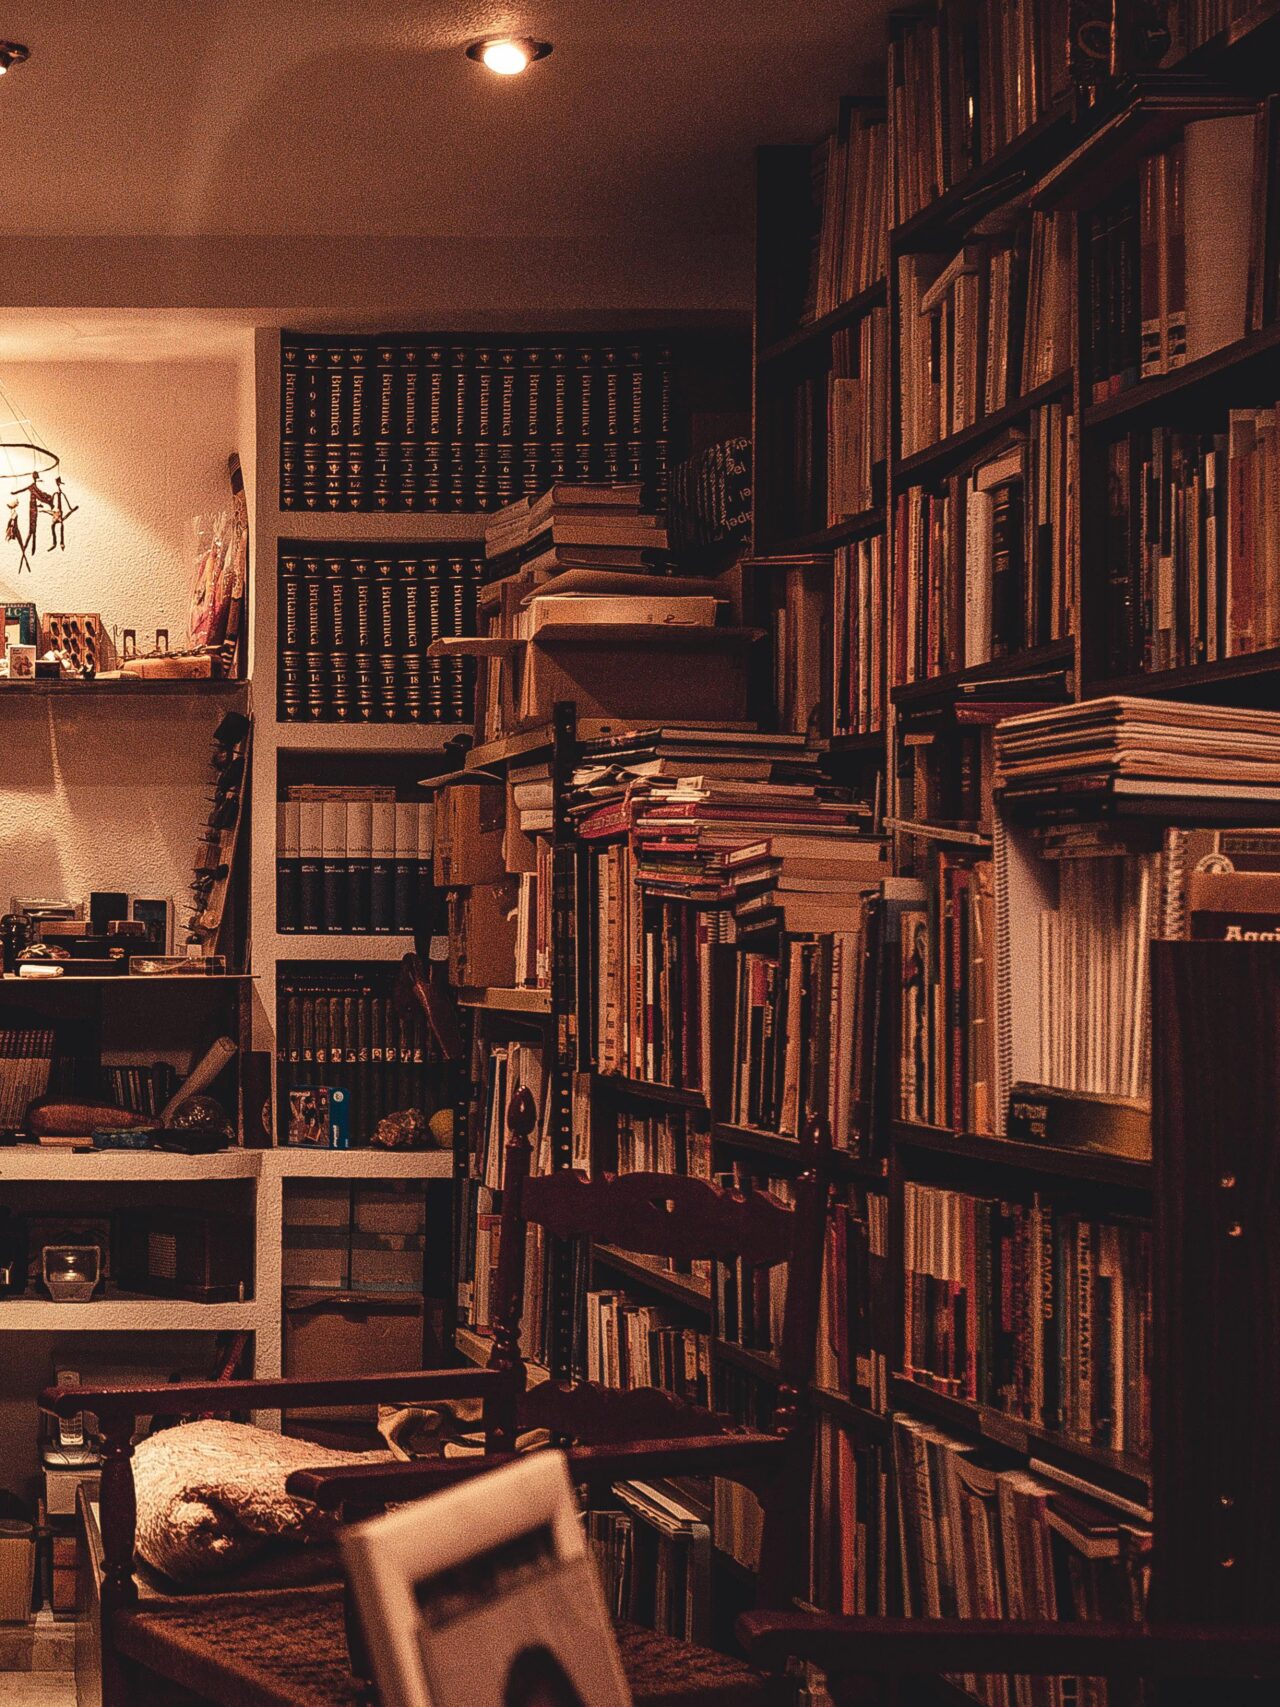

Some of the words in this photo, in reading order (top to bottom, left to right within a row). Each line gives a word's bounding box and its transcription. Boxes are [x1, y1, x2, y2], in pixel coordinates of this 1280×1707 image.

[285, 373, 296, 434] Britannica
[330, 375, 342, 436] Britannica
[352, 375, 364, 436] Britannica
[381, 373, 393, 435] Britannica
[406, 373, 417, 435] Britannica
[431, 373, 442, 434] Britannica
[457, 374, 466, 435] Britannica
[480, 375, 491, 435] Britannica
[503, 376, 514, 436] Britannica
[528, 374, 540, 435] Britannica
[555, 374, 565, 435] Britannica
[582, 375, 592, 436] Britannica
[607, 374, 618, 435] Britannica
[632, 373, 643, 434] Britannica
[287, 583, 297, 644] Britannica
[309, 584, 320, 645] Britannica
[332, 584, 344, 645] Britannica
[358, 585, 369, 646] Britannica
[381, 586, 393, 647] Britannica
[406, 586, 418, 647] Britannica
[429, 585, 441, 642] Britannic
[453, 585, 465, 638] Britanni
[1040, 1206, 1053, 1240] THE
[1080, 1236, 1090, 1266] The
[1041, 1243, 1054, 1320] SAVIOUR
[1080, 1269, 1090, 1313] three
[1080, 1317, 1090, 1381] MARYS
